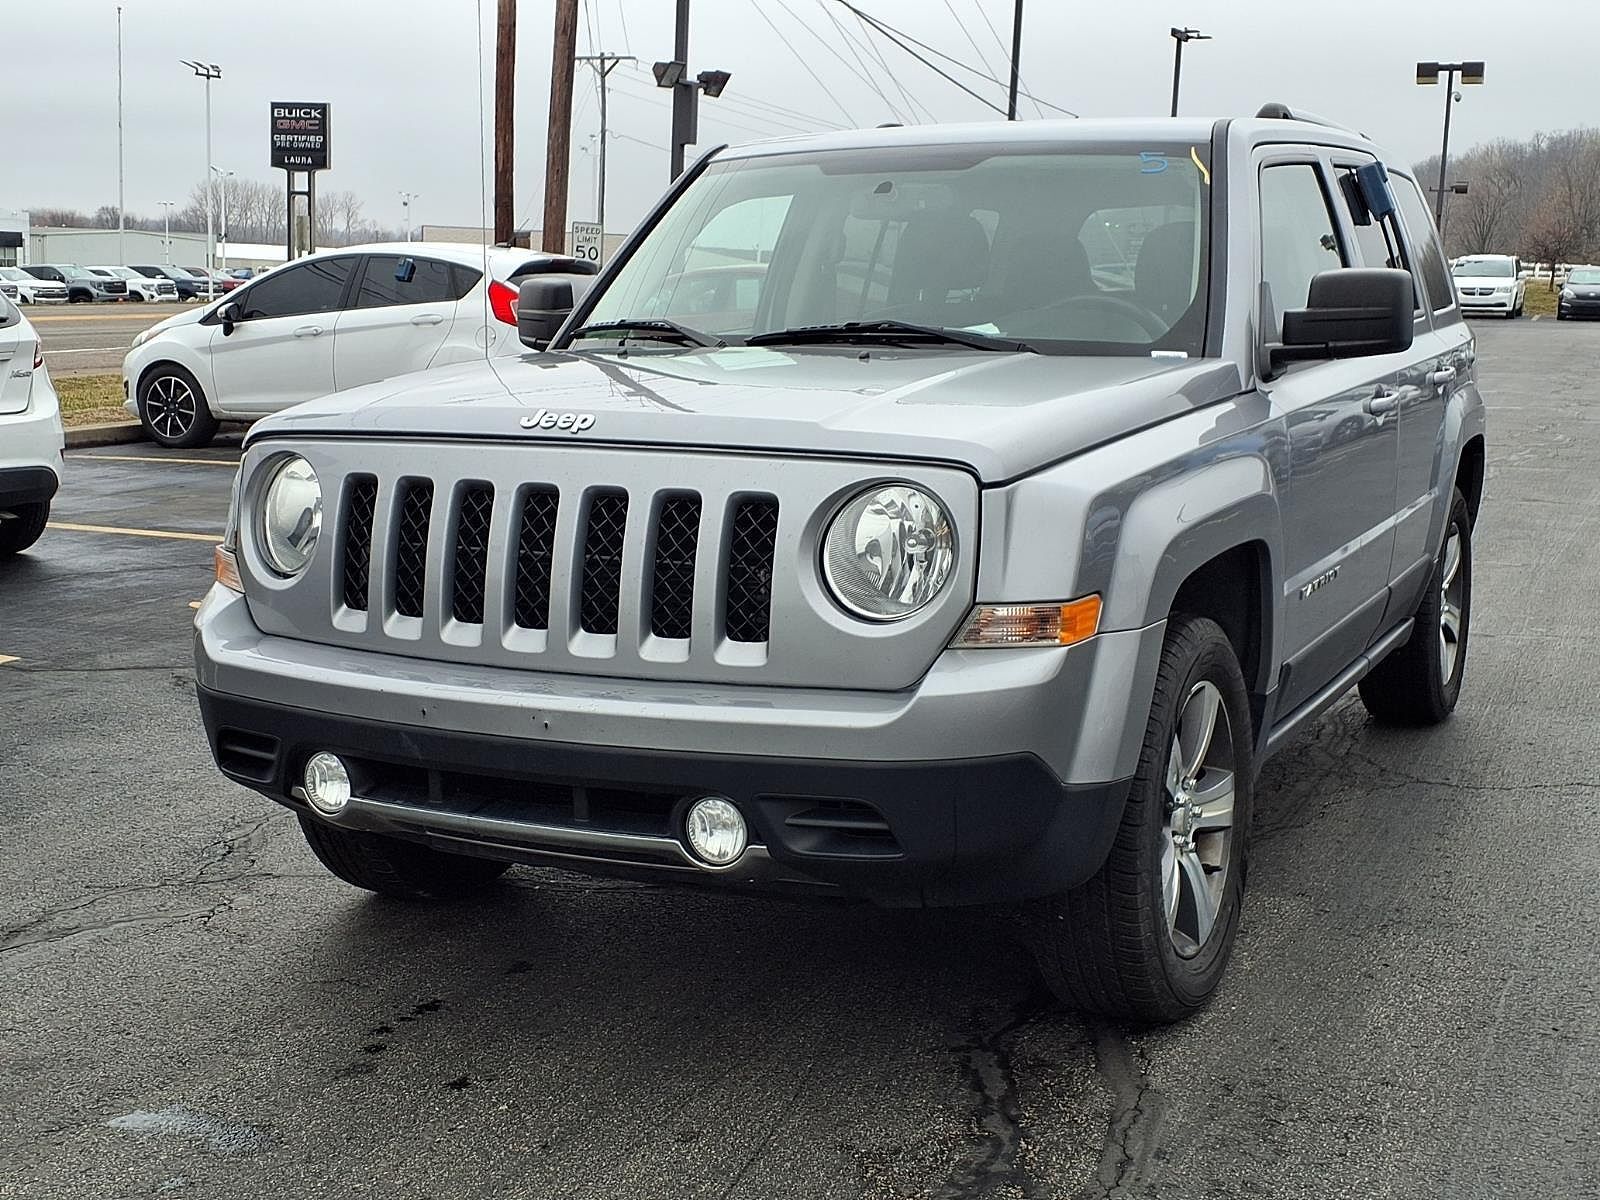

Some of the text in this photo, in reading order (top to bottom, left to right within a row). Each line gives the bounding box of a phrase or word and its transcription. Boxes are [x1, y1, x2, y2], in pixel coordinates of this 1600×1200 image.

[274, 108, 322, 118] BUICK
[276, 119, 319, 130] GMC
[273, 134, 323, 143] CERTIFIED
[285, 155, 313, 165] LAURA
[574, 225, 601, 235] SPEED
[577, 235, 598, 244] LIMIT
[575, 245, 599, 261] 50
[519, 408, 597, 434] Jeep
